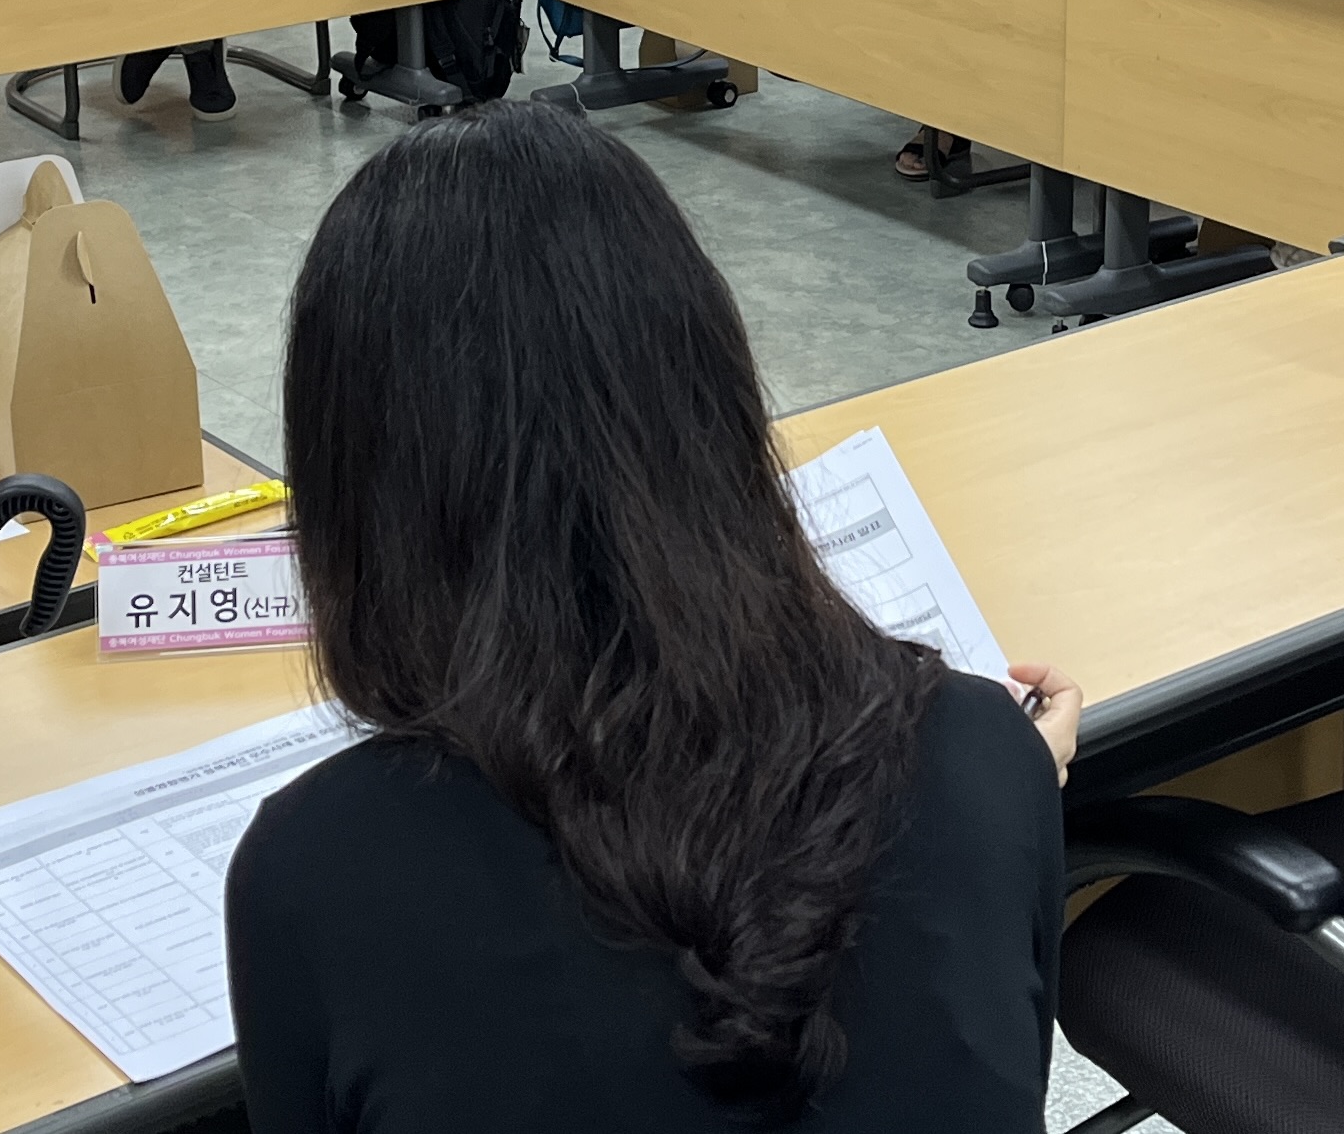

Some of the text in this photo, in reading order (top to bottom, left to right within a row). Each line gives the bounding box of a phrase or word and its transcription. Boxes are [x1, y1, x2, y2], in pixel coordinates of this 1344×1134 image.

[224, 546, 262, 557] Women
[177, 562, 249, 584] 컨설턴트
[224, 629, 262, 640] Women
